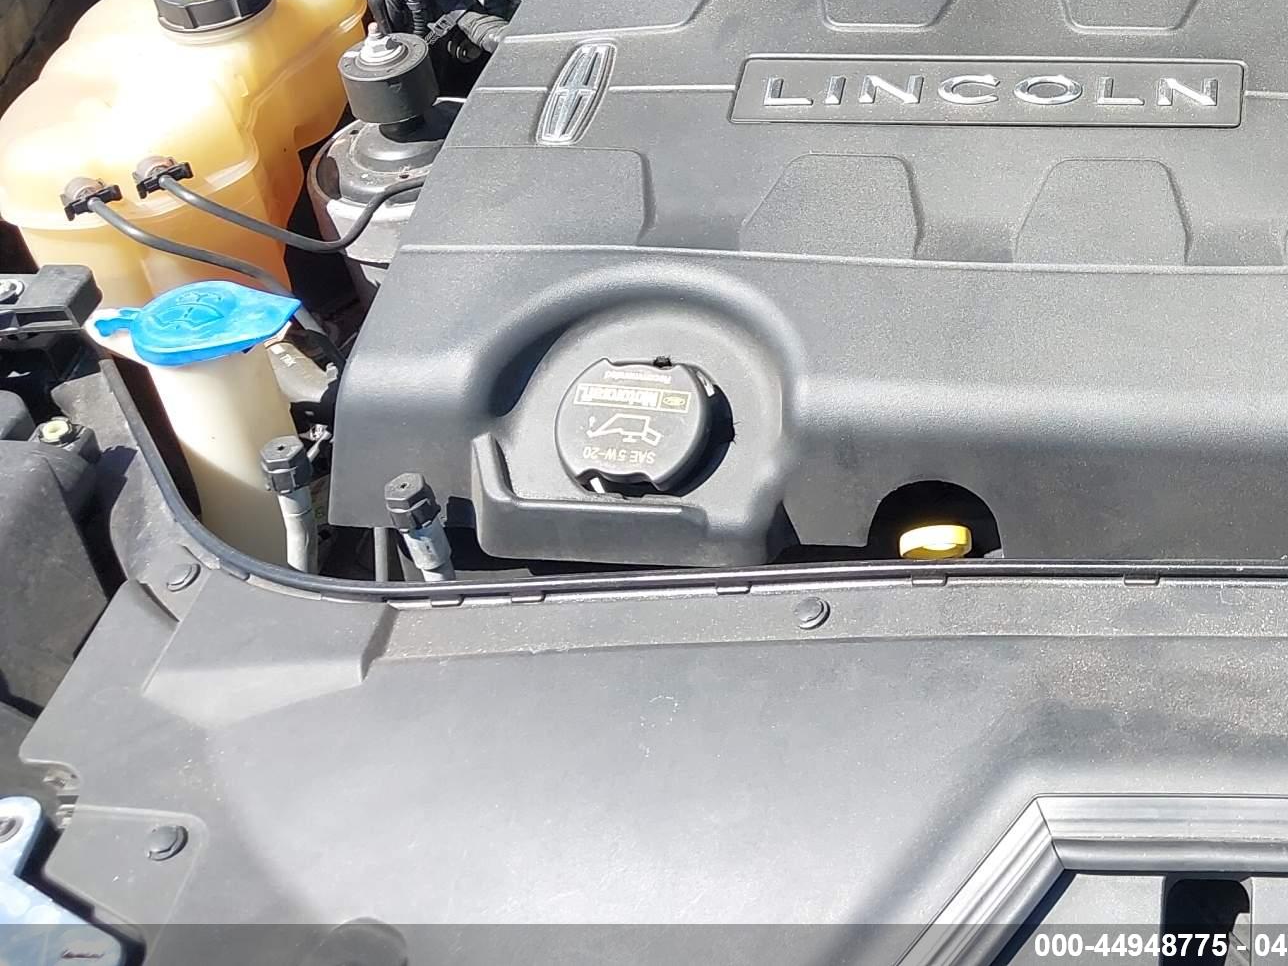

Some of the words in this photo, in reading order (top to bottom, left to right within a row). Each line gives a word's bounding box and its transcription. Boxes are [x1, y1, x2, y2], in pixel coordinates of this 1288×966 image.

[762, 74, 1217, 107] LINCOLN
[604, 370, 672, 384] Recommended
[581, 386, 658, 407] Motorcraft
[583, 446, 630, 462] 5W-20
[630, 447, 656, 464] SAE
